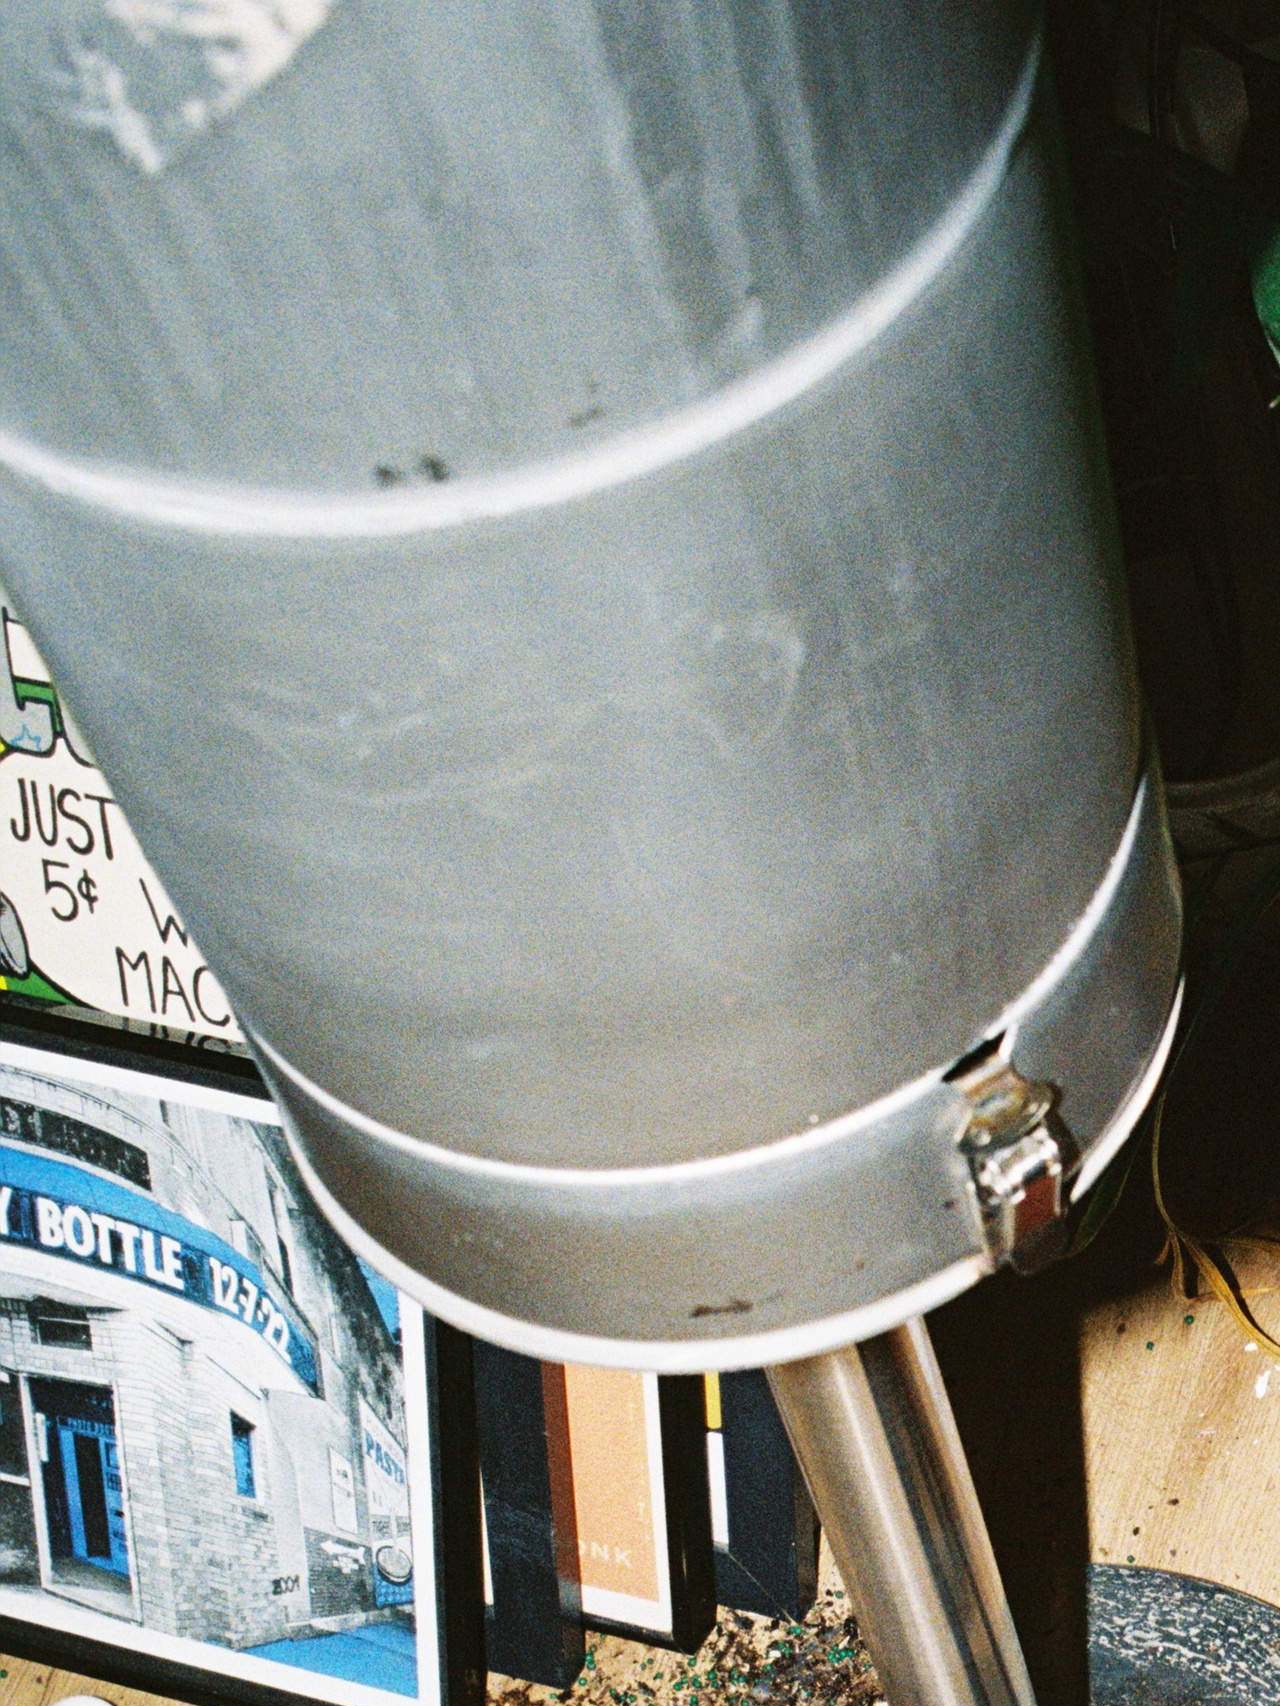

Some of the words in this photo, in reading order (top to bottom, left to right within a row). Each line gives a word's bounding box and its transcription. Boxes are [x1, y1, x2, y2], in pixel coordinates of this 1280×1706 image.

[10, 777, 119, 861] JUST
[41, 858, 99, 922] 5¢
[35, 1197, 185, 1290] BOTTLE
